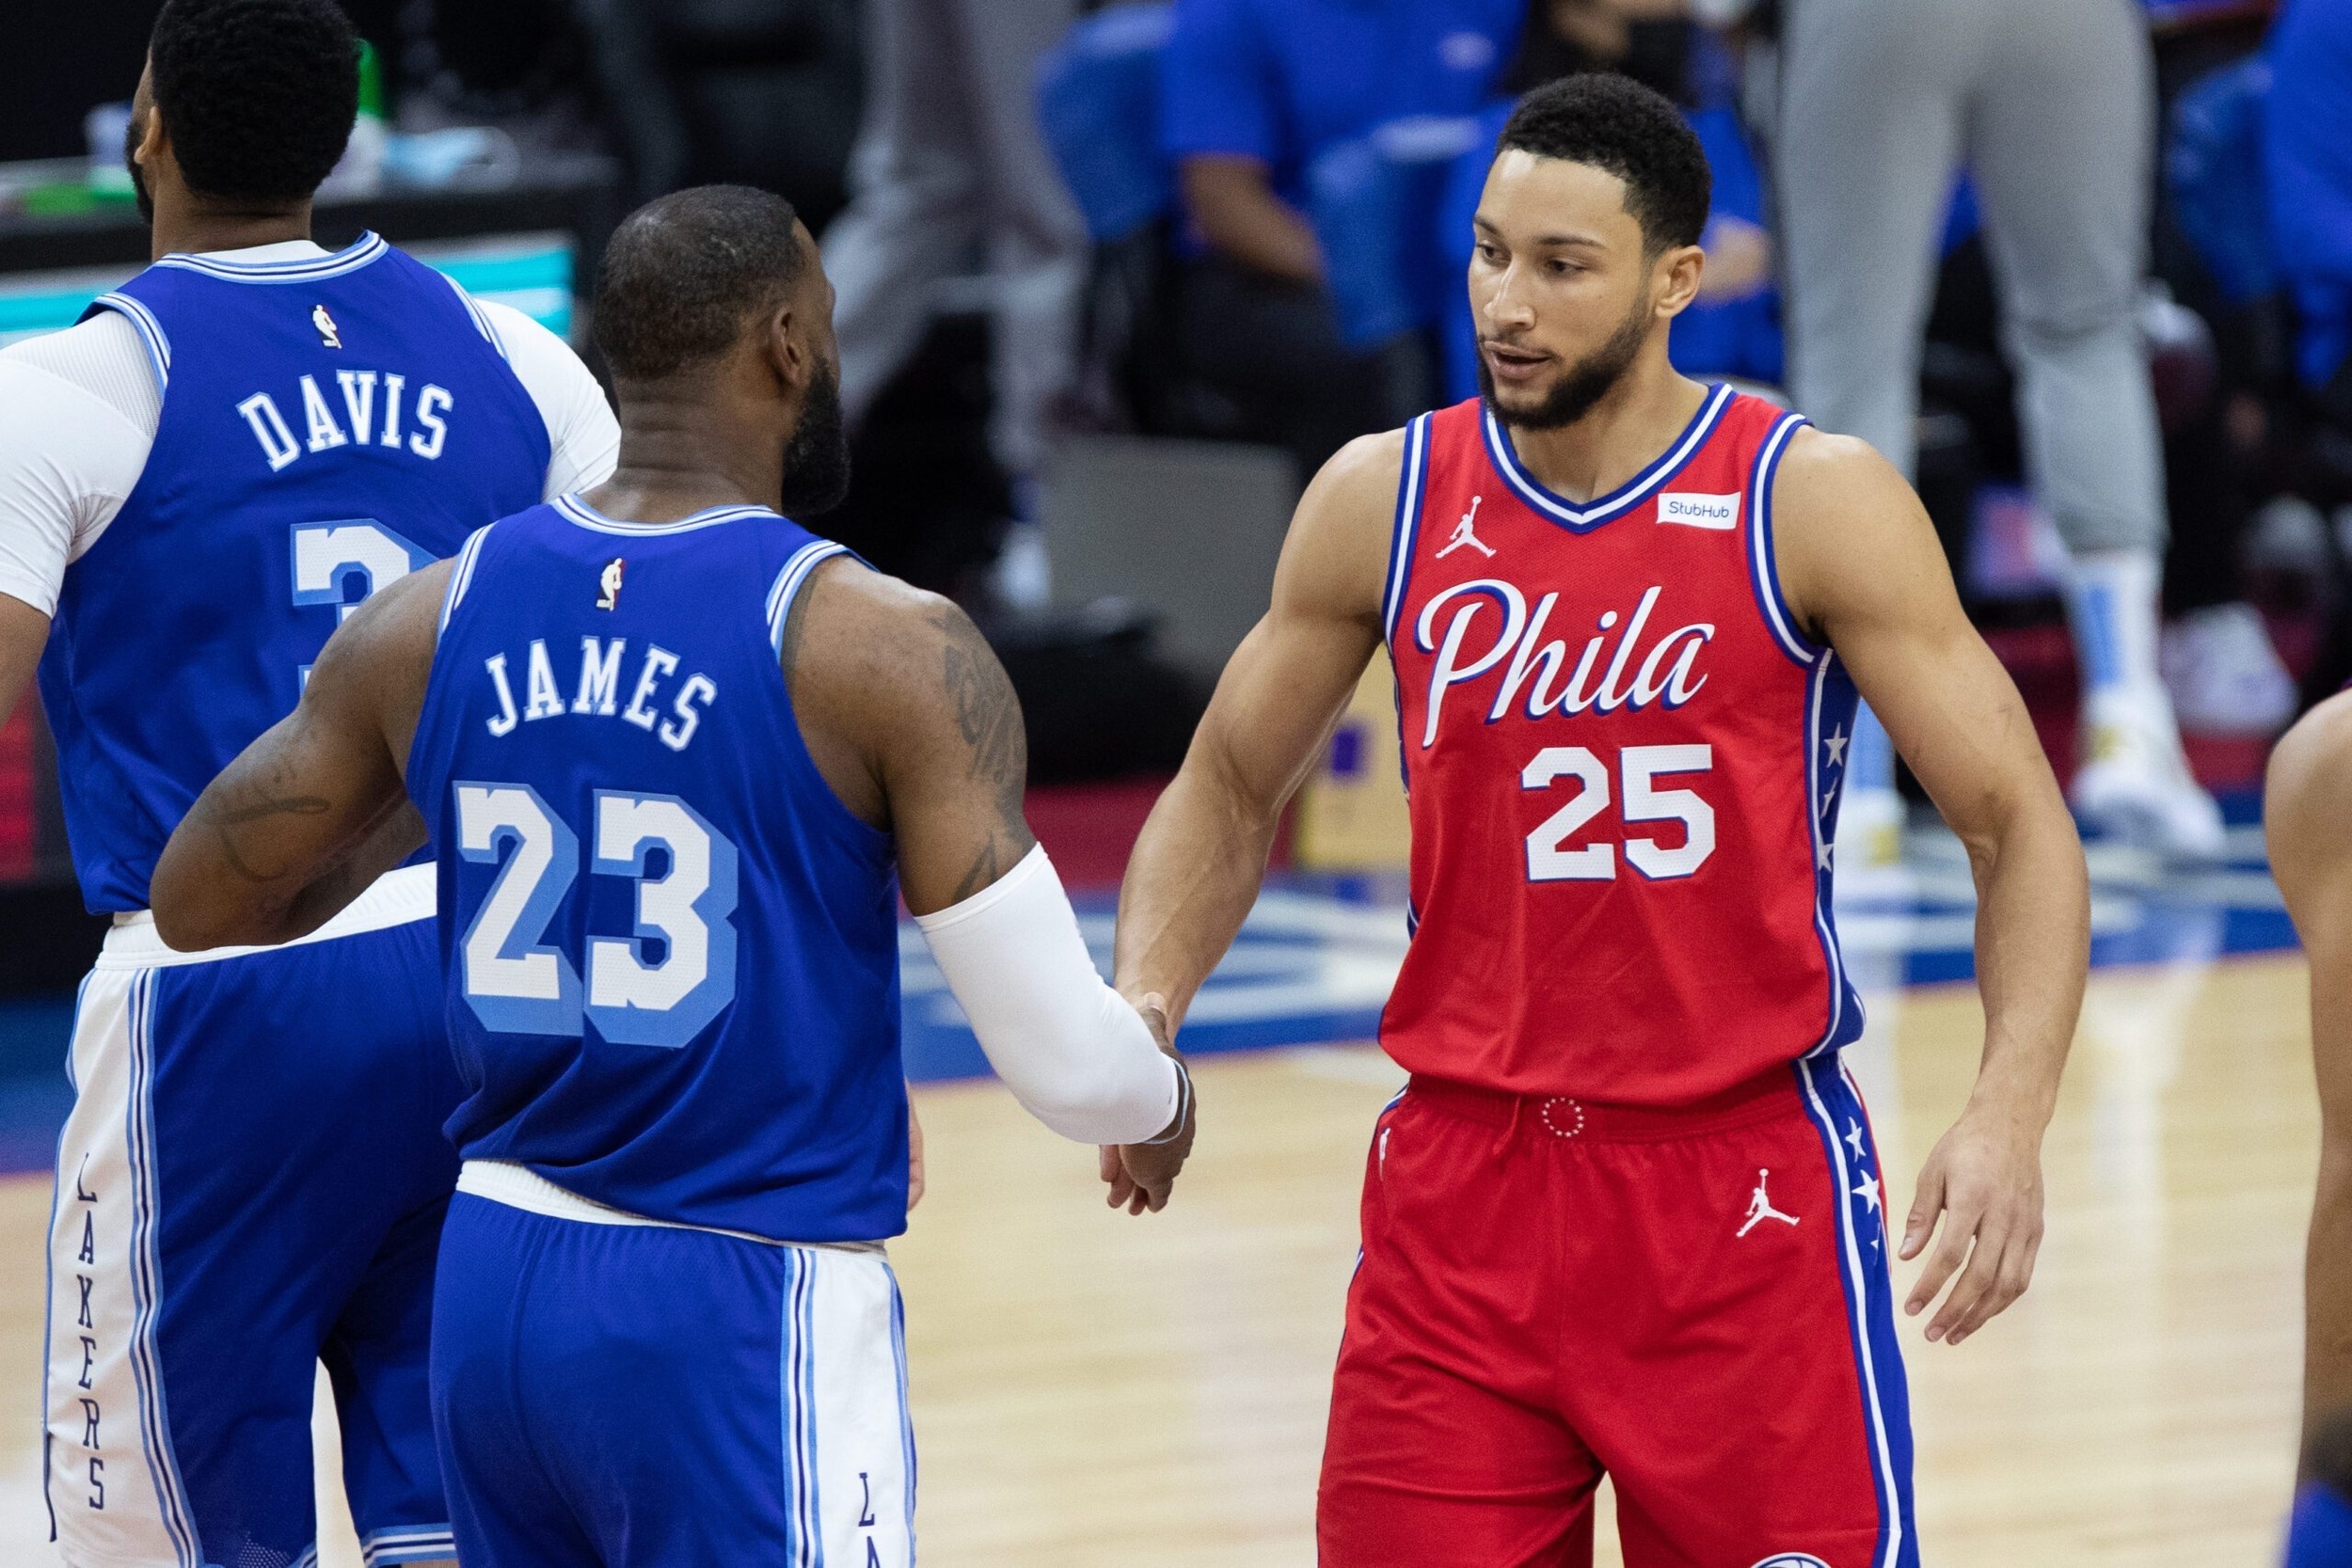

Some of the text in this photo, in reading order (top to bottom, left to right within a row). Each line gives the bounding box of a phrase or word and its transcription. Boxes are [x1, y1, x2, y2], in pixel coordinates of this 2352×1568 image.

[234, 369, 455, 473] DAVIS
[1668, 500, 1730, 518] StubHub
[484, 635, 719, 752] JAMES
[1413, 578, 1716, 751] Phila
[1520, 743, 1717, 882] 25
[453, 780, 739, 1049] 23
[76, 1151, 105, 1511] LAKERS
